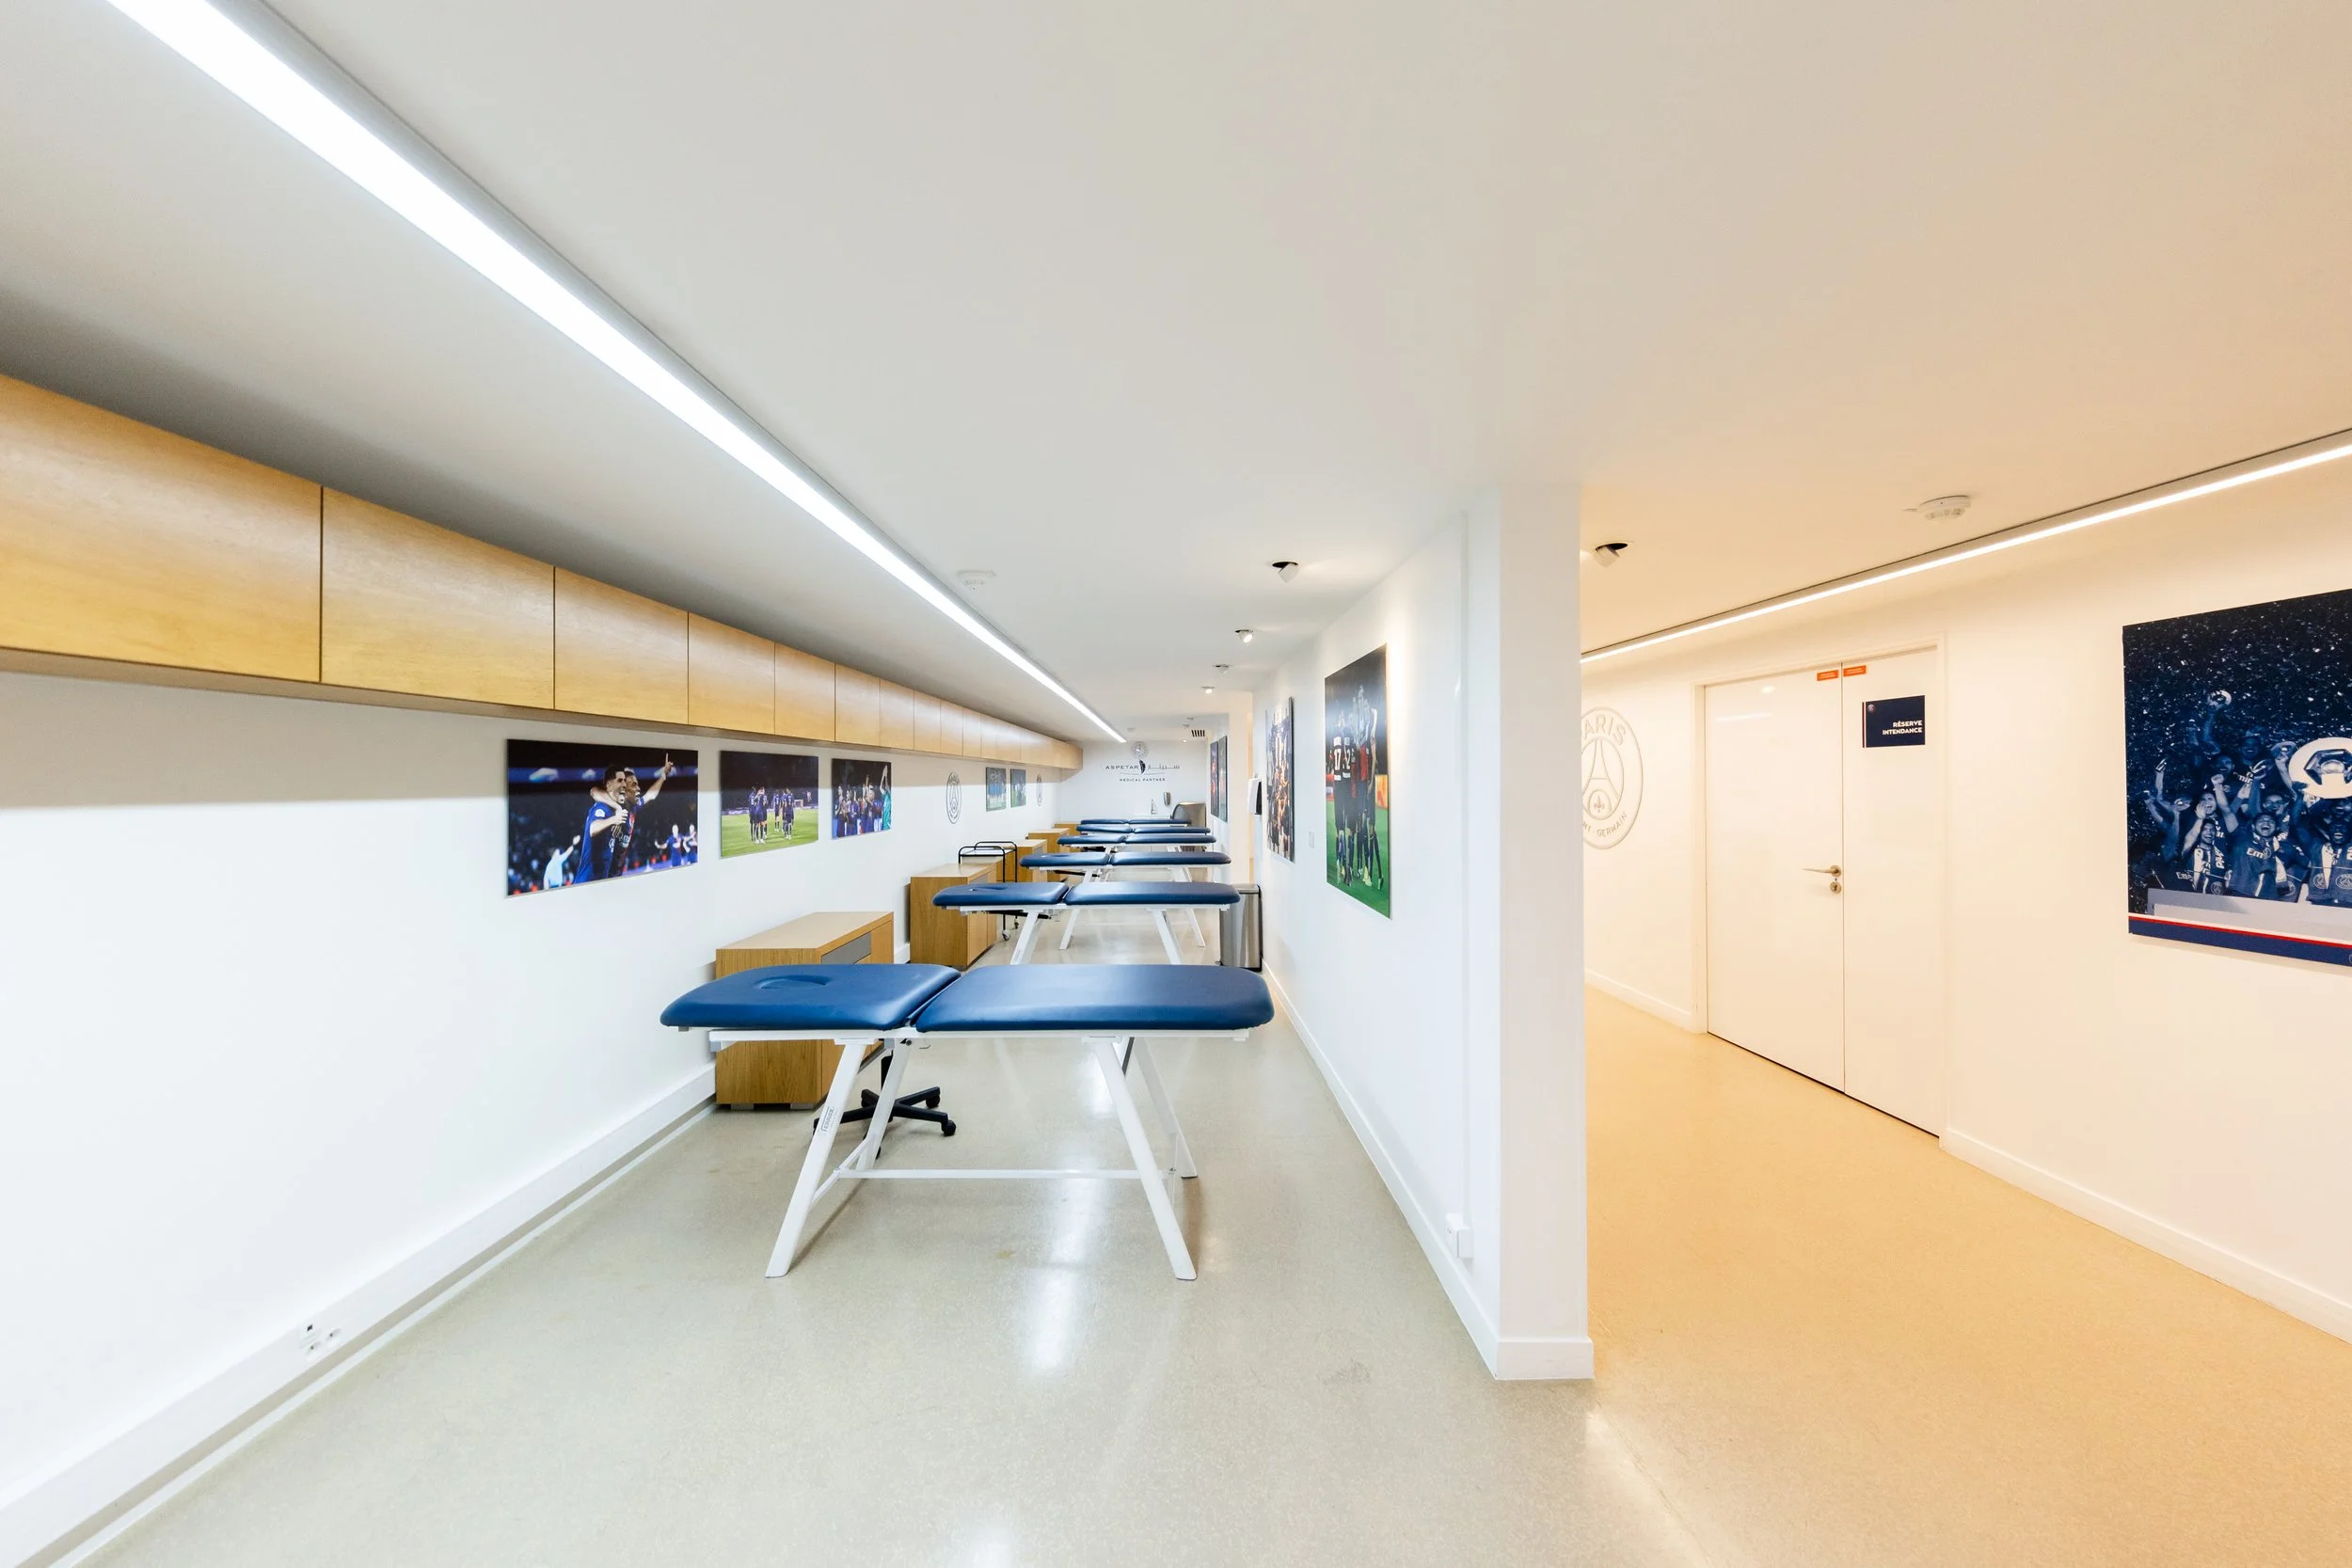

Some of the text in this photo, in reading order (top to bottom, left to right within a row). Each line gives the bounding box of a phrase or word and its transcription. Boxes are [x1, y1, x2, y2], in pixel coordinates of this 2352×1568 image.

[1583, 714, 1627, 746] ARIS
[1882, 727, 1923, 736] INTENDANCE
[1334, 748, 1342, 770] 17
